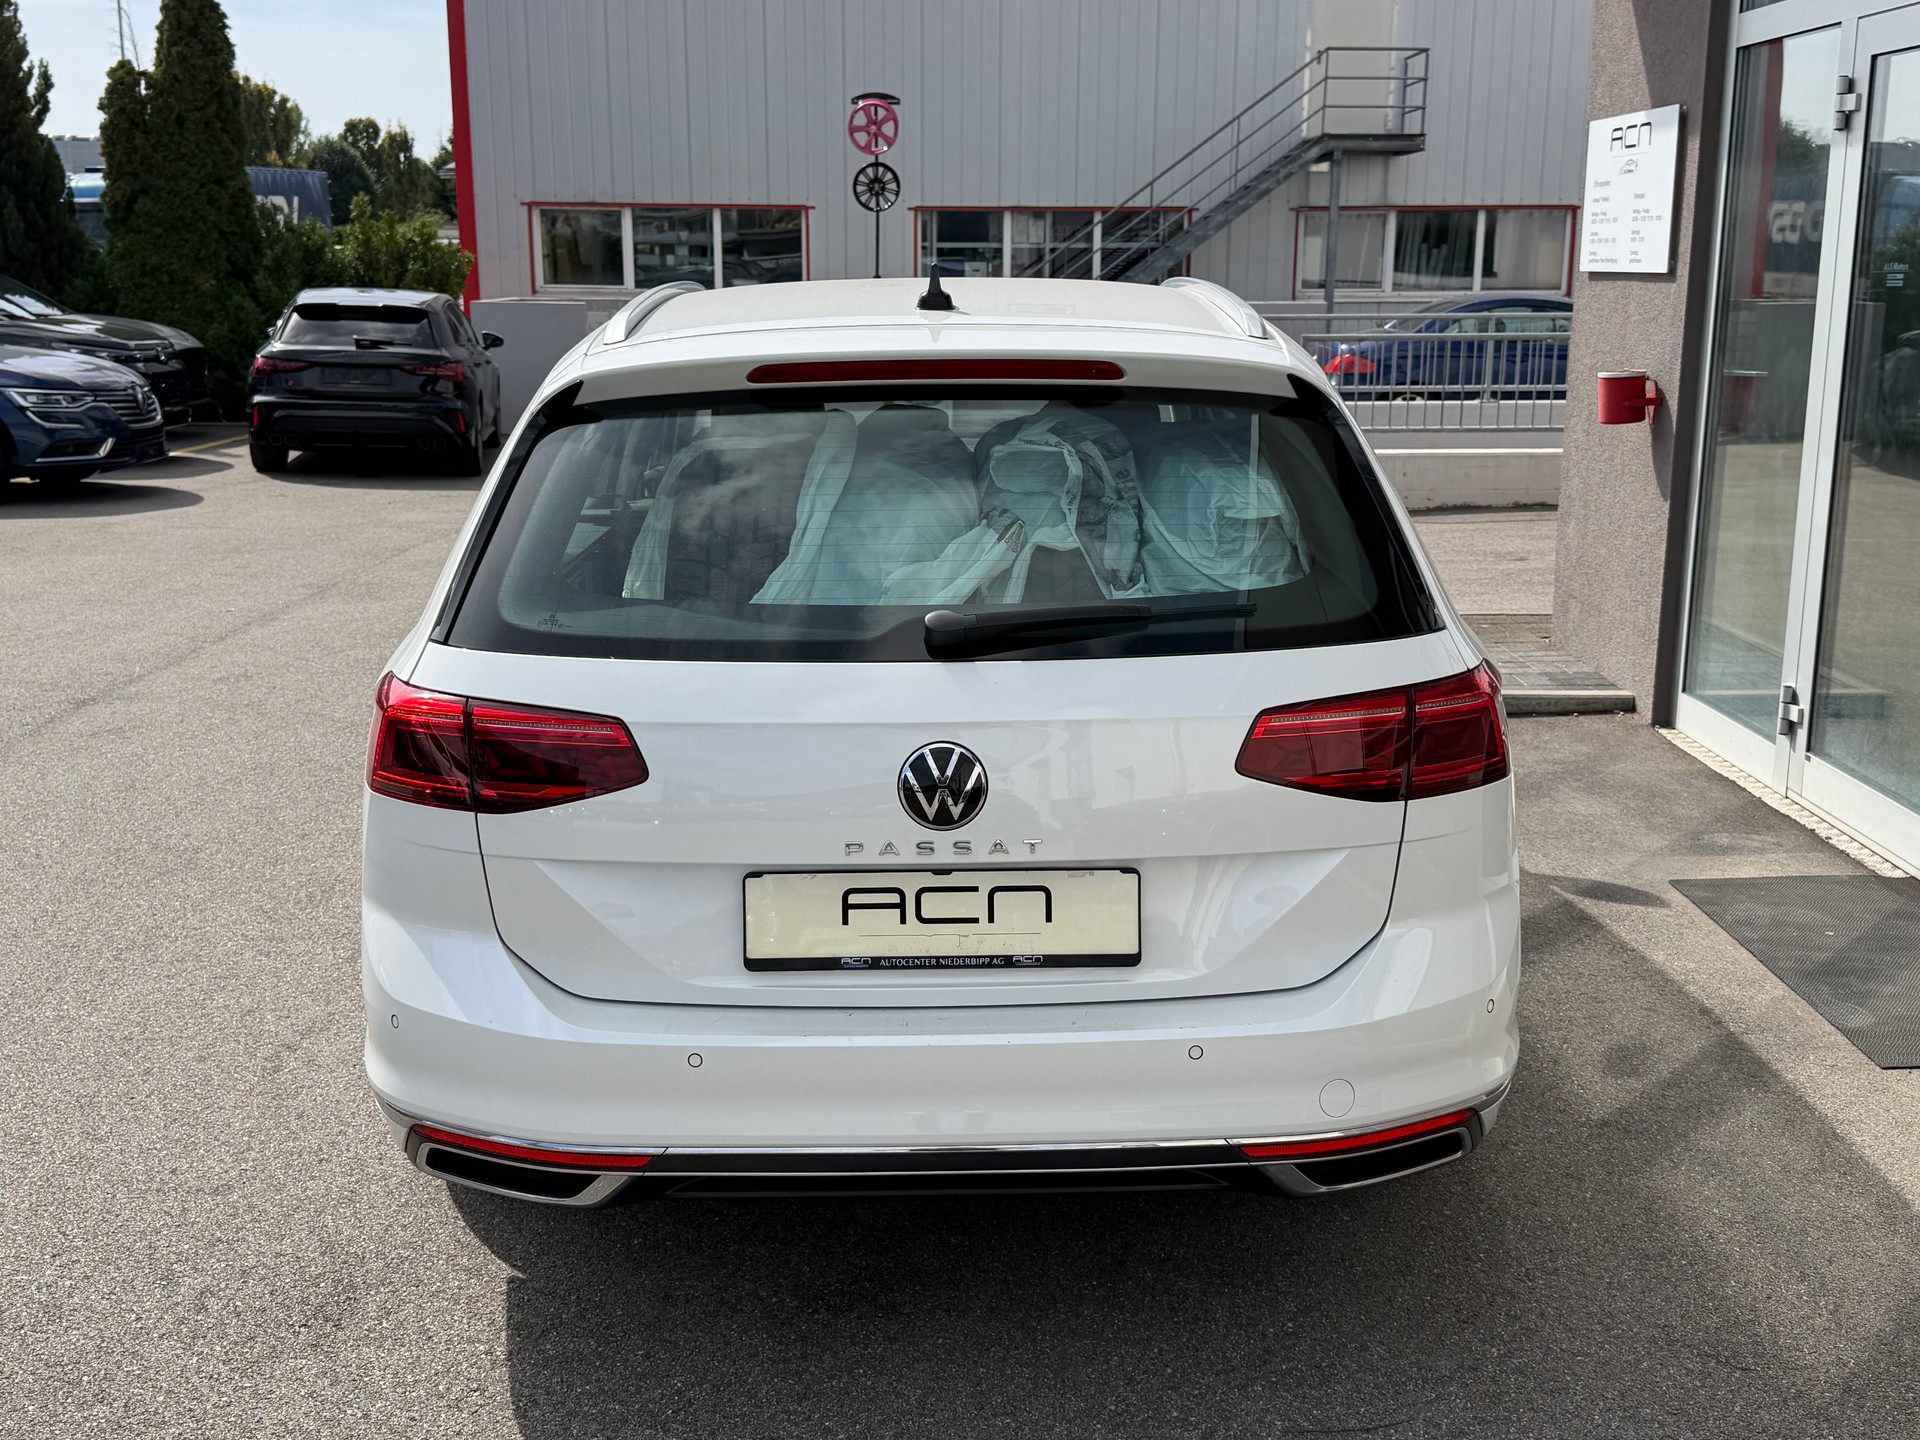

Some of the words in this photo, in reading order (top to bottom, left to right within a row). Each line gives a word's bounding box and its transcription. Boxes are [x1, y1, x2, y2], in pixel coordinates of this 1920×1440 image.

[844, 838, 1044, 857] PASSAT
[879, 958, 938, 967] AUTOCENTER
[939, 957, 991, 966] NIEDERBIPP
[991, 956, 1005, 966] AG
